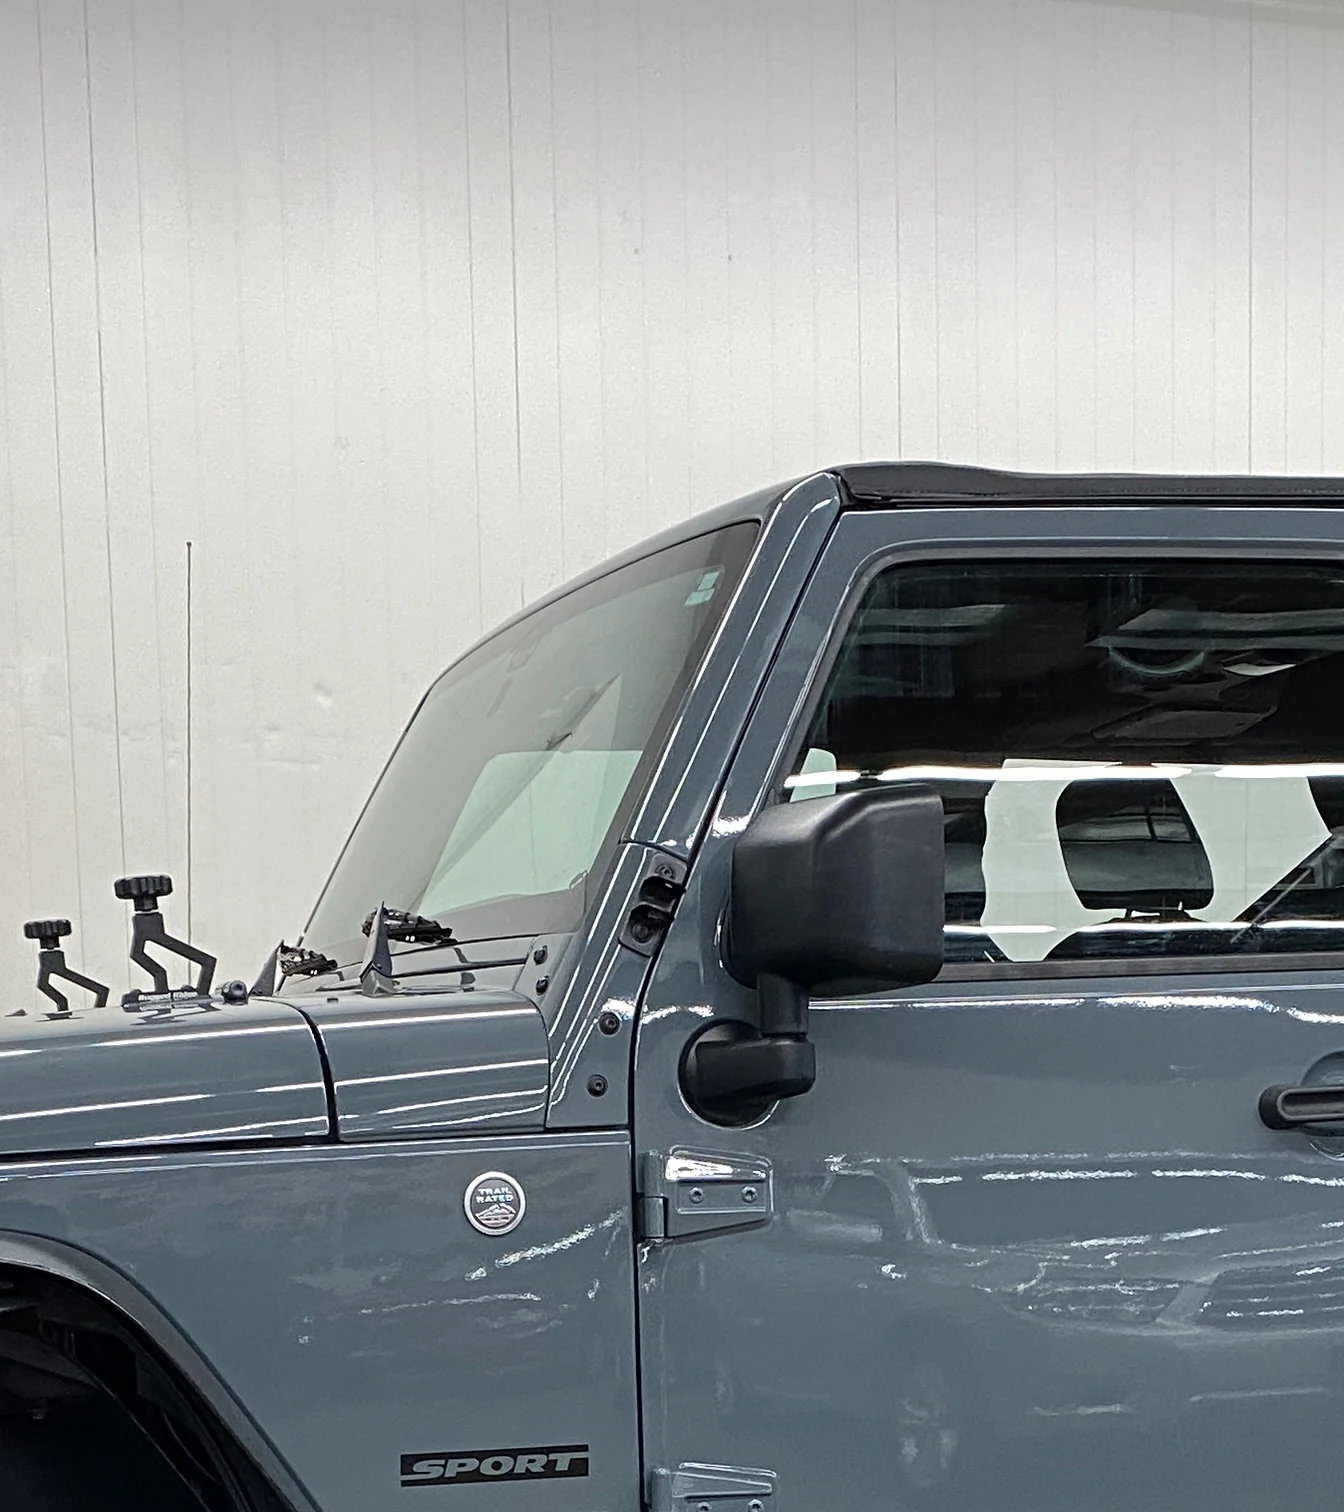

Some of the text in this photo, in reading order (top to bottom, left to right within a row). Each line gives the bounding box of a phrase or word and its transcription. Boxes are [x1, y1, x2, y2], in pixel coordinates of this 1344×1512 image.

[477, 1187, 512, 1195] TRAIL
[476, 1194, 514, 1204] RATED
[401, 1452, 589, 1481] SPORT
